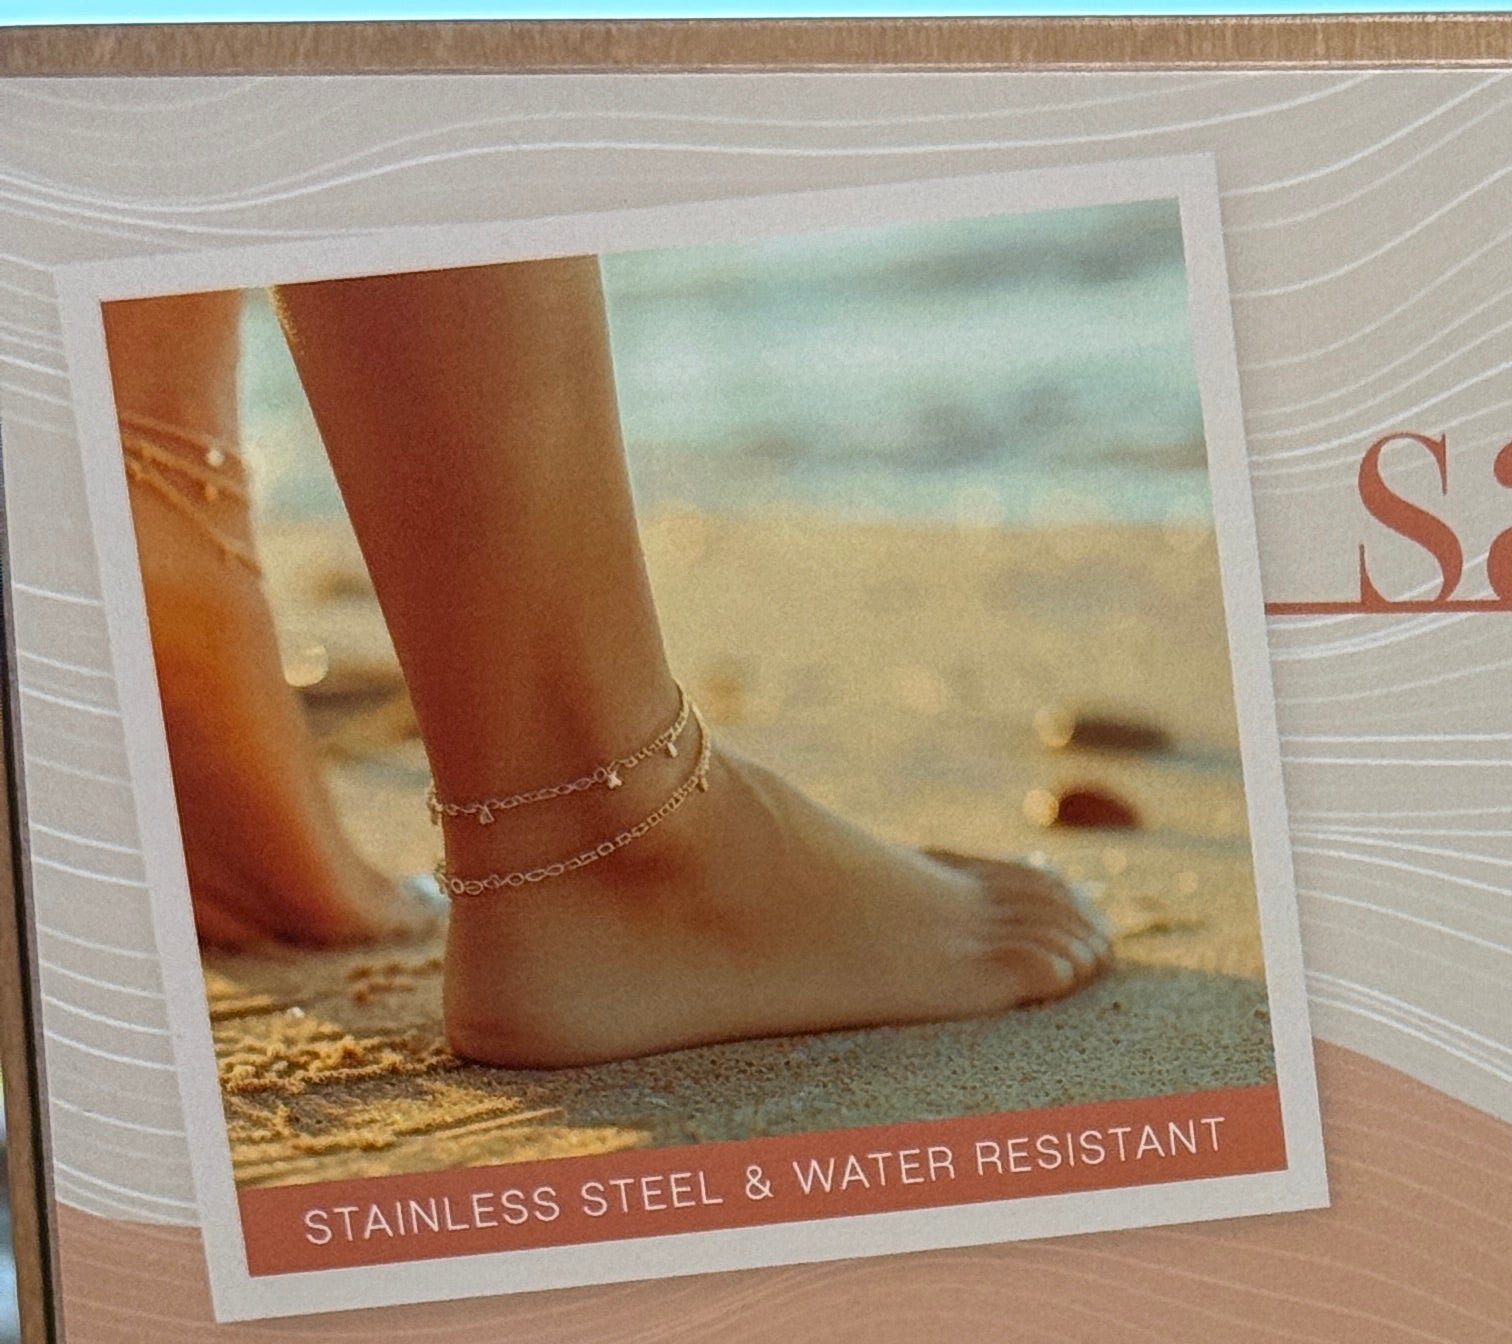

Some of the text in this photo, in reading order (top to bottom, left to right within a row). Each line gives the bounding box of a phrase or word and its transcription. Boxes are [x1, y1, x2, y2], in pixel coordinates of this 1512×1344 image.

[303, 1116, 1227, 1247] STAINLESS STEEL & WATER RESISTANT
